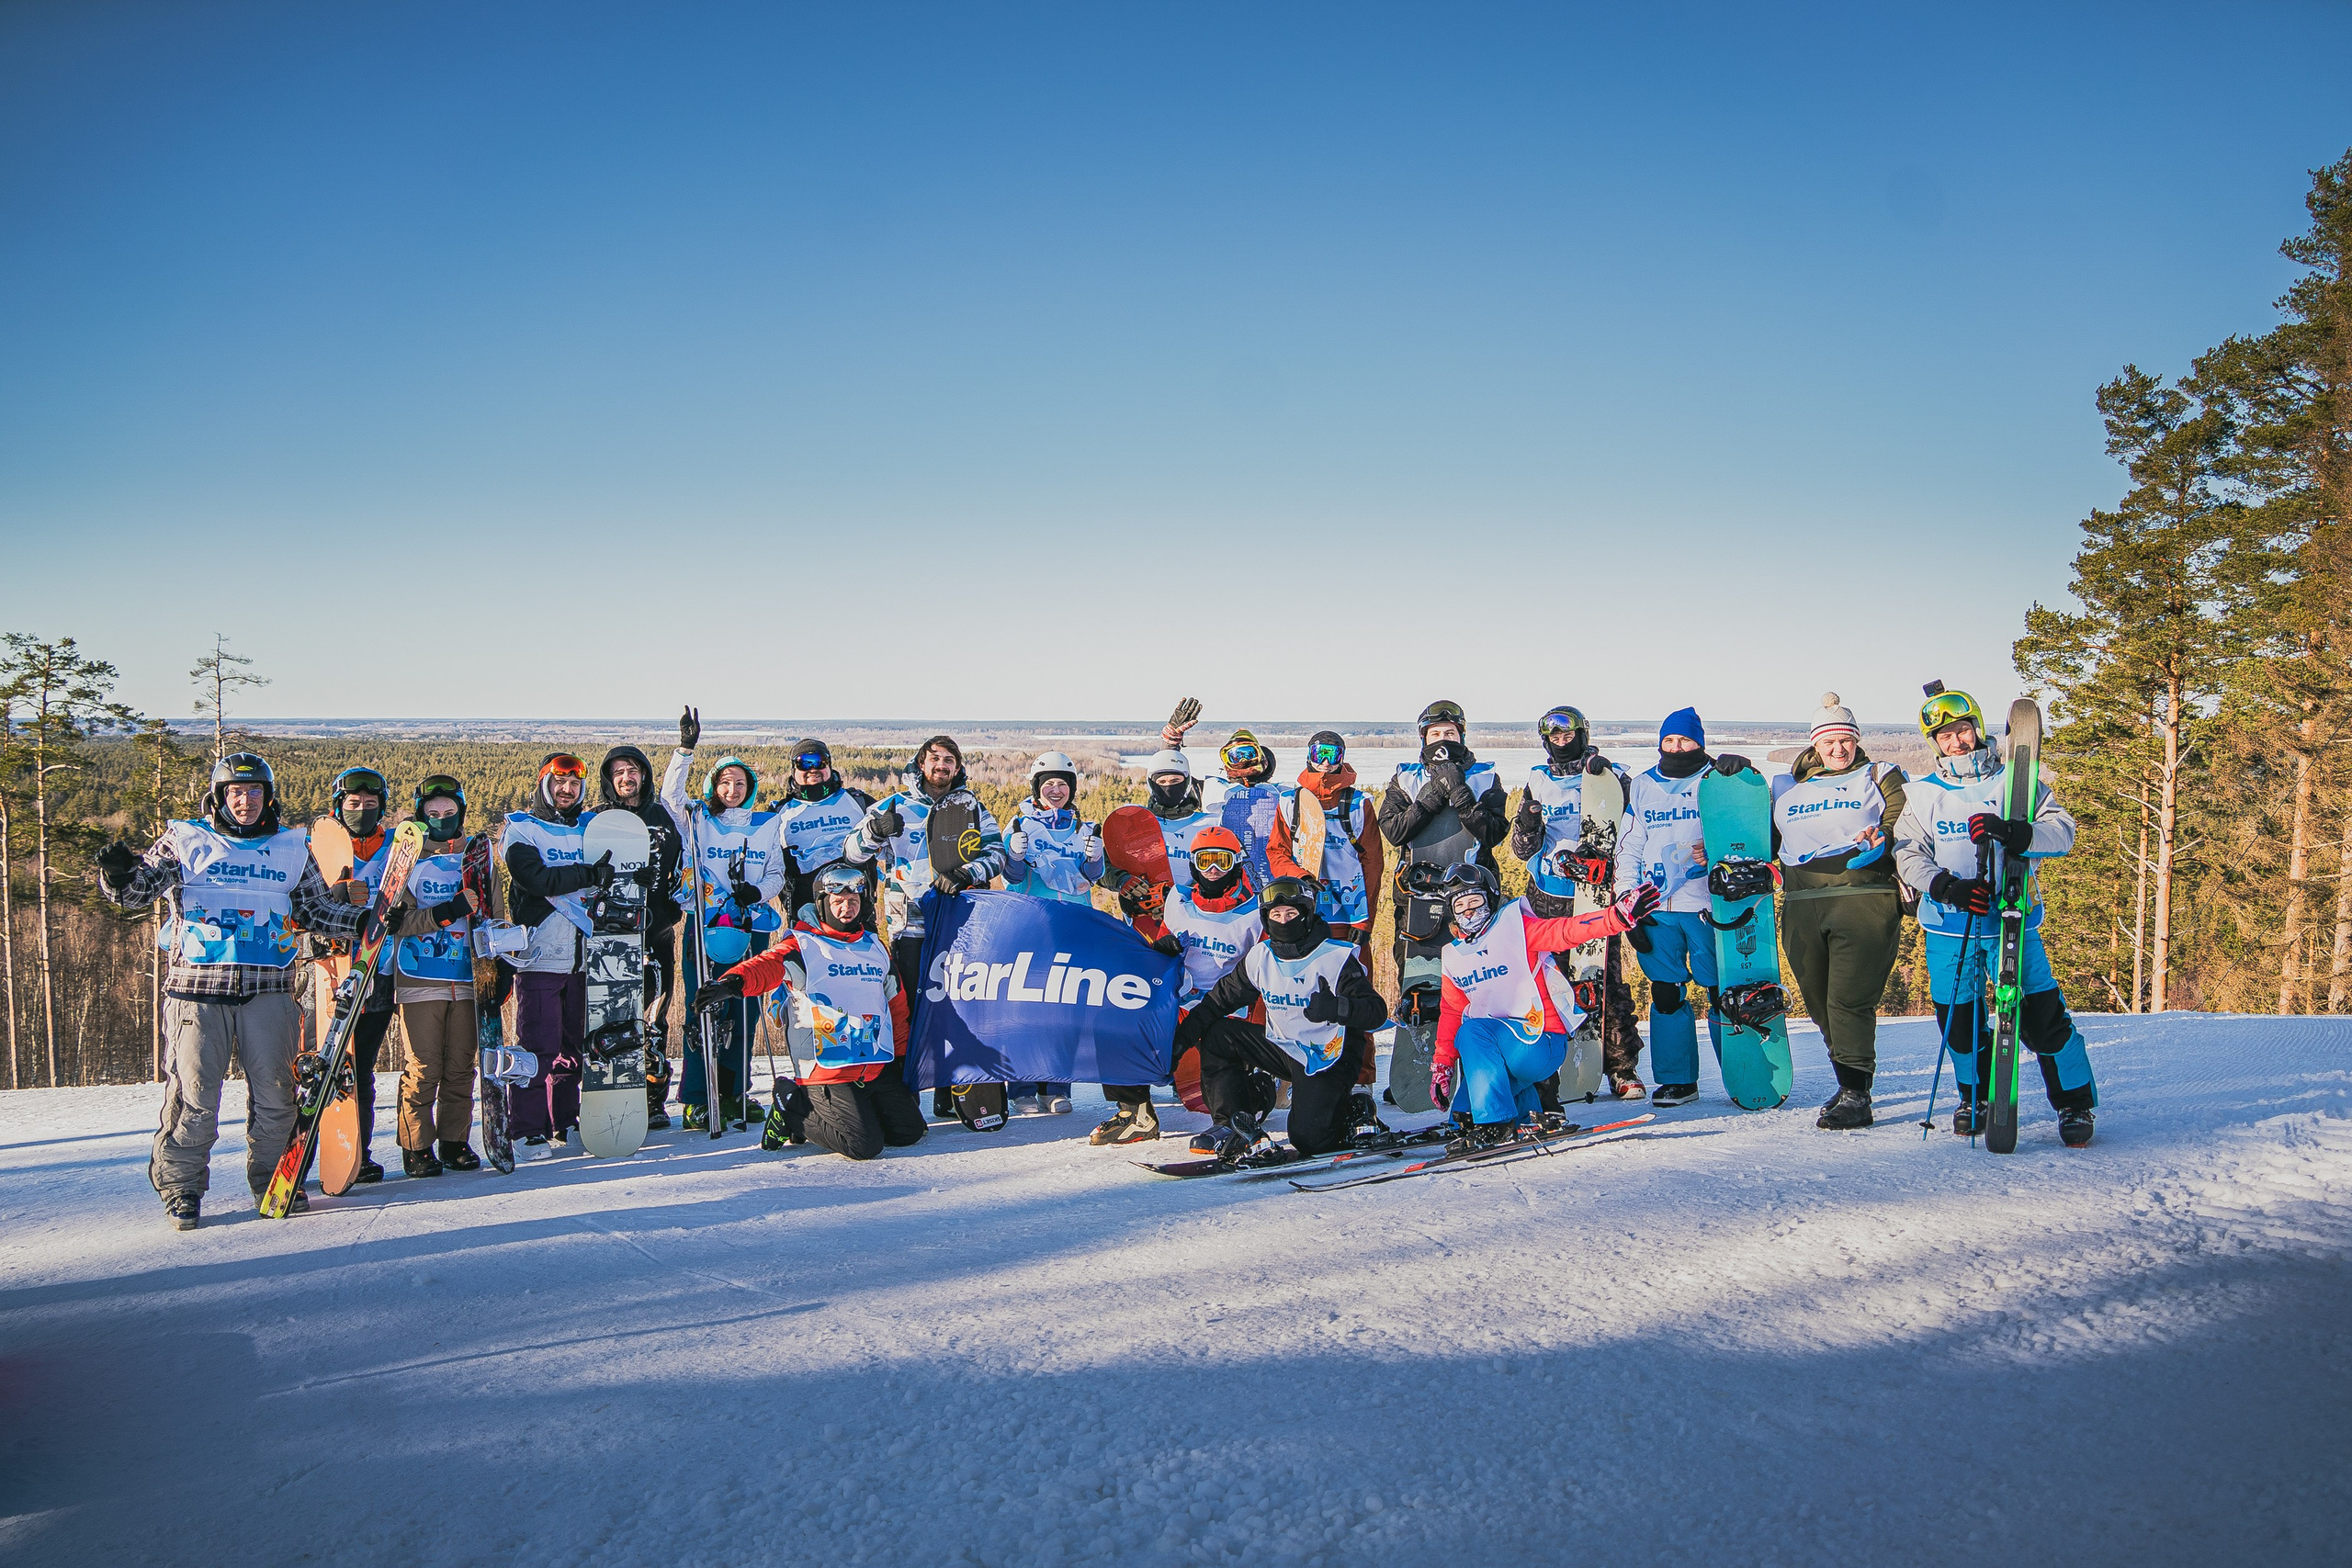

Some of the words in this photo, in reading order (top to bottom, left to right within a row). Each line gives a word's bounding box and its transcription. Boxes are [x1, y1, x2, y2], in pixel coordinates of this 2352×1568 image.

[1542, 802, 1581, 816] StarLi
[1787, 798, 1861, 817] StarLine
[789, 815, 851, 834] StarLine
[547, 847, 583, 862] StarLi
[1034, 839, 1084, 859] StarLin
[206, 861, 287, 882] StarLine
[423, 880, 460, 894] Star
[828, 963, 884, 976] StarLine
[1261, 987, 1311, 1008] tarLin
